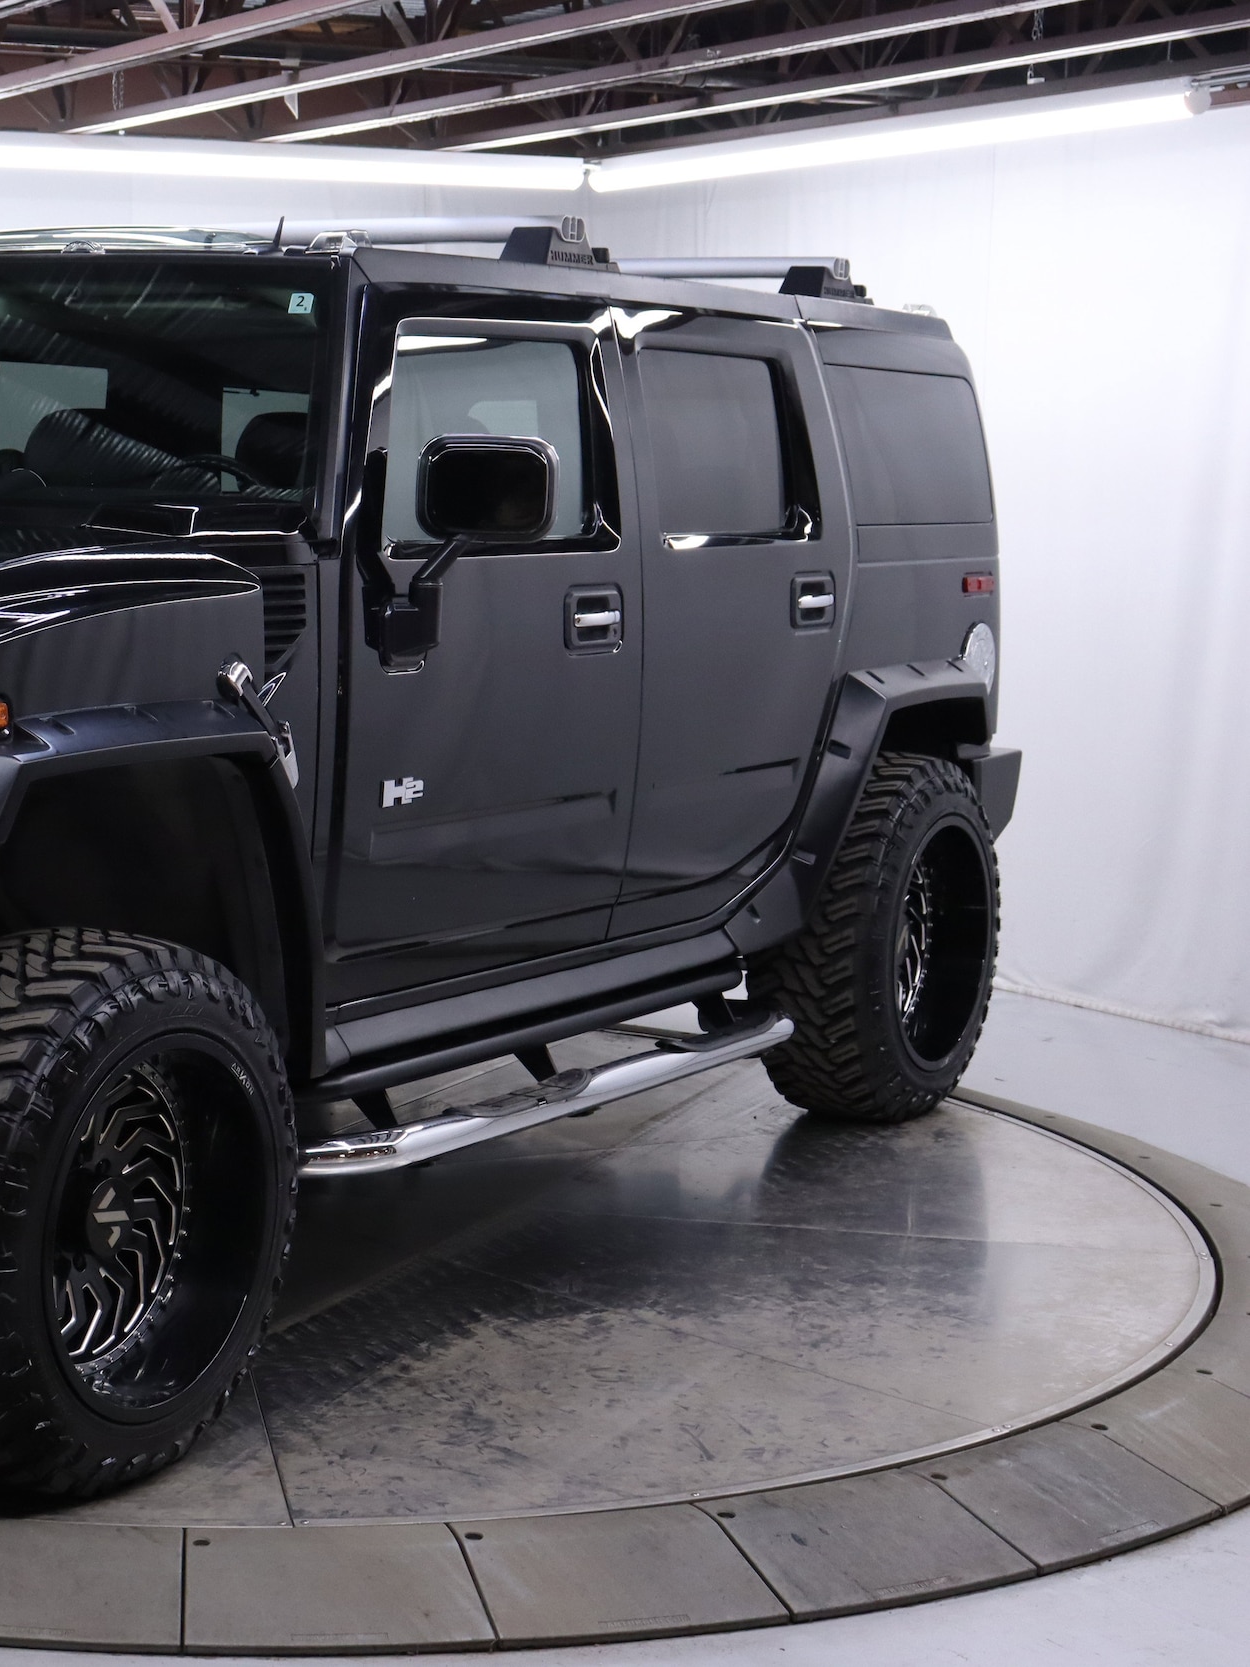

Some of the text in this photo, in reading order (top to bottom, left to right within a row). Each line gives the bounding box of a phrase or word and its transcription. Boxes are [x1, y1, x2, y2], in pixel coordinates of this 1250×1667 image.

[550, 250, 594, 265] HUMMER
[296, 295, 305, 307] 2
[380, 776, 424, 808] H2
